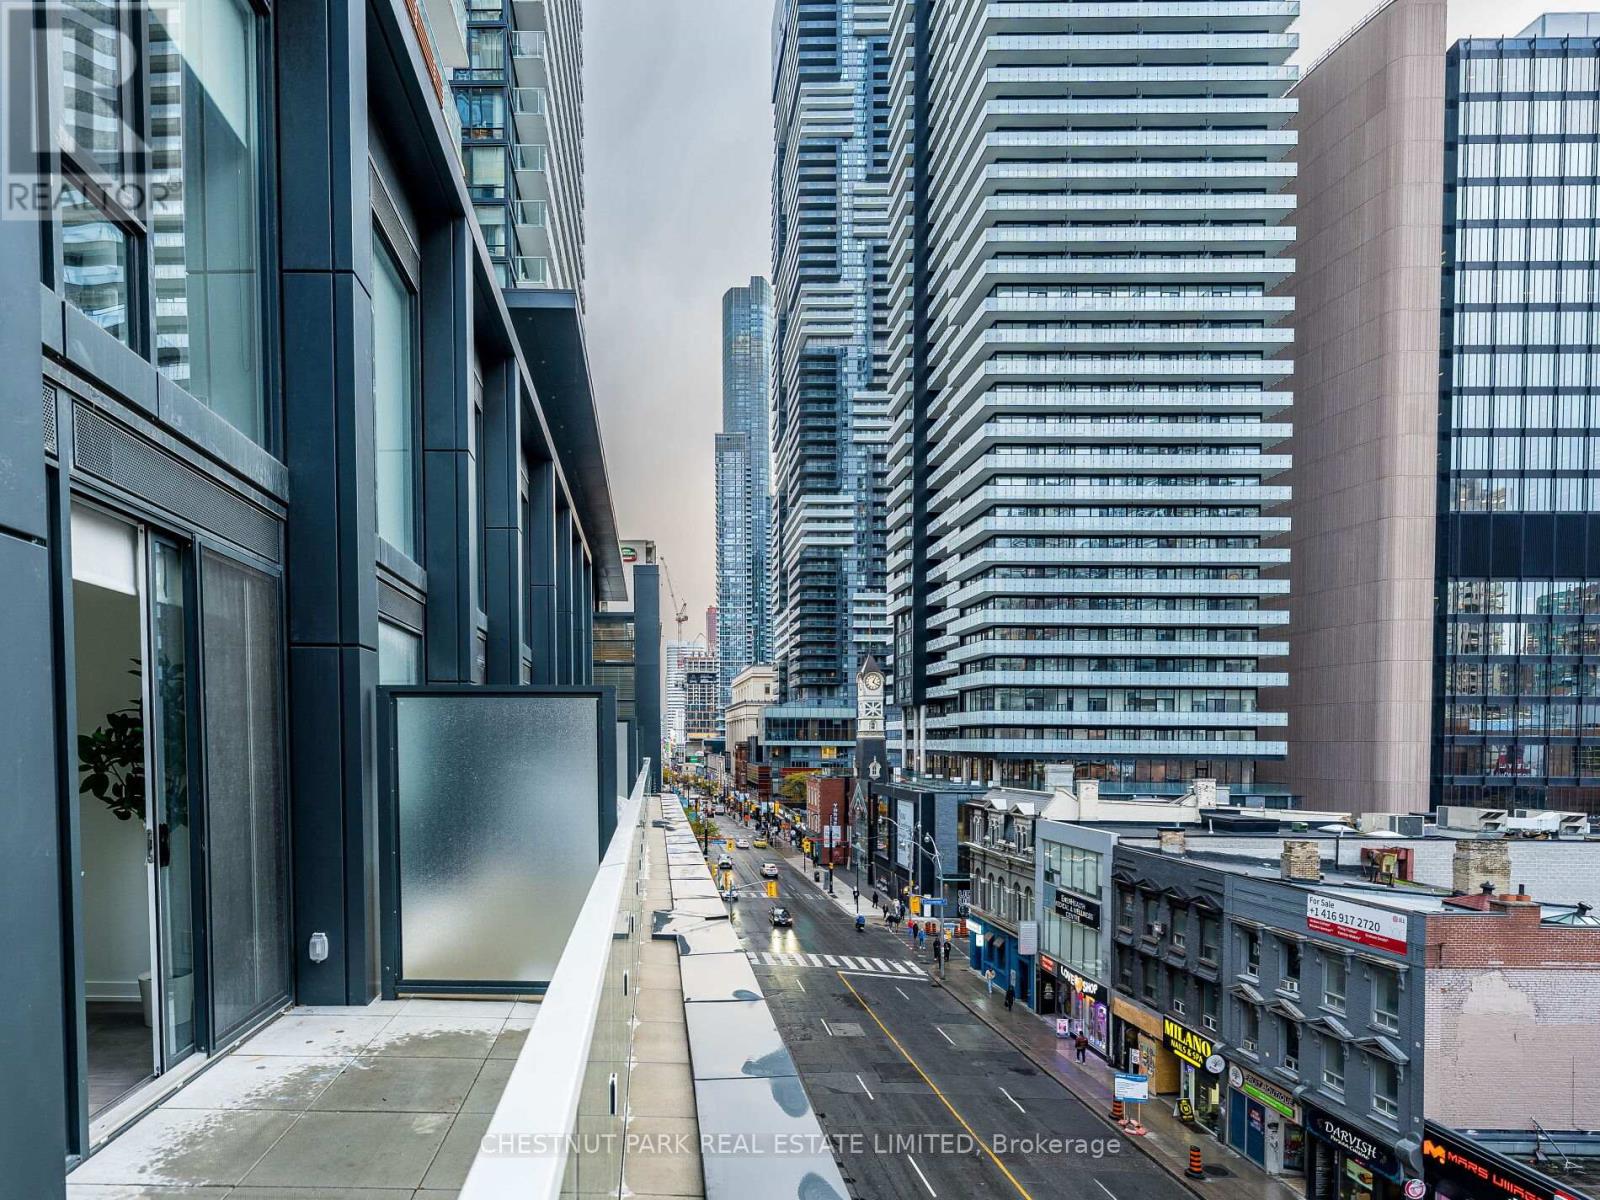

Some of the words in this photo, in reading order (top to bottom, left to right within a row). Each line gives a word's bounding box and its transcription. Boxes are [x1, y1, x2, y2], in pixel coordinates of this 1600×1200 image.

[1309, 897, 1320, 905] For
[1320, 899, 1335, 909] Sale
[1310, 907, 1319, 917] +1
[1320, 908, 1337, 921] 416
[1338, 914, 1355, 926] 917
[1357, 917, 1381, 932] 2720
[1060, 965, 1076, 986] LOVE
[1082, 980, 1098, 995] SHOP
[1164, 1019, 1212, 1058] MILANO
[1170, 1039, 1187, 1054] NAILS
[1192, 1051, 1204, 1064] SPA
[1324, 1121, 1377, 1159] DARVISH
[1448, 1151, 1489, 1180] MARS
